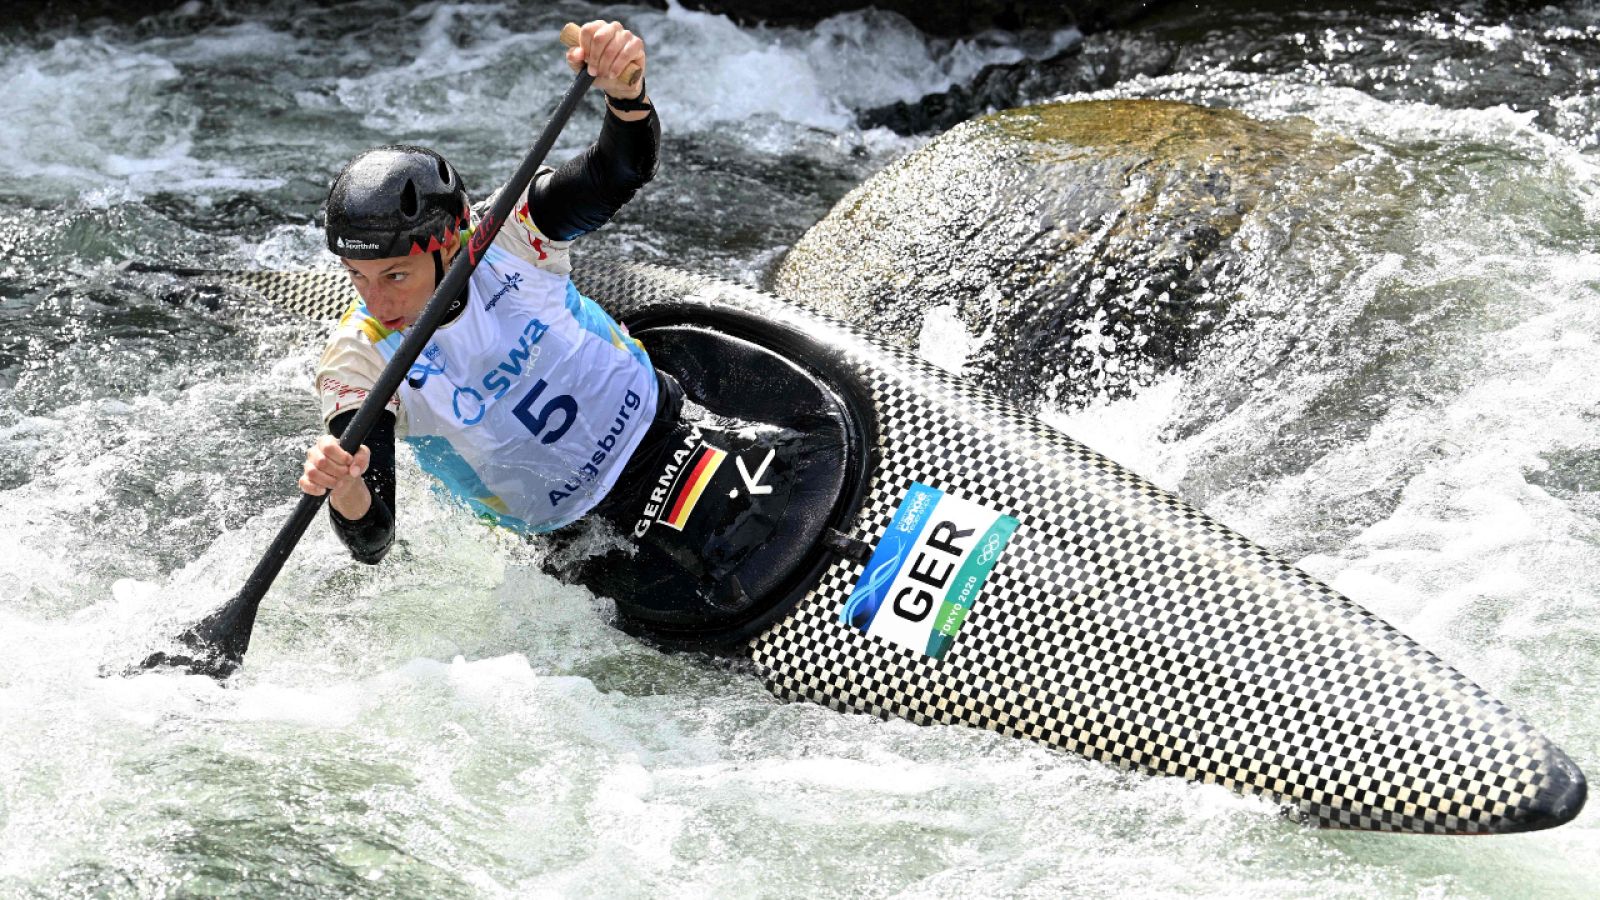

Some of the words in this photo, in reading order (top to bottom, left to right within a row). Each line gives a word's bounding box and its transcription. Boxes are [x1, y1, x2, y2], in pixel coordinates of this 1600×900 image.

[482, 318, 549, 400] swa
[511, 378, 578, 445] 5
[548, 389, 641, 507] Augsburg
[634, 424, 703, 538] GERMAN
[892, 520, 976, 623] GER
[938, 603, 962, 637] TOKYO
[958, 575, 977, 603] 2020
